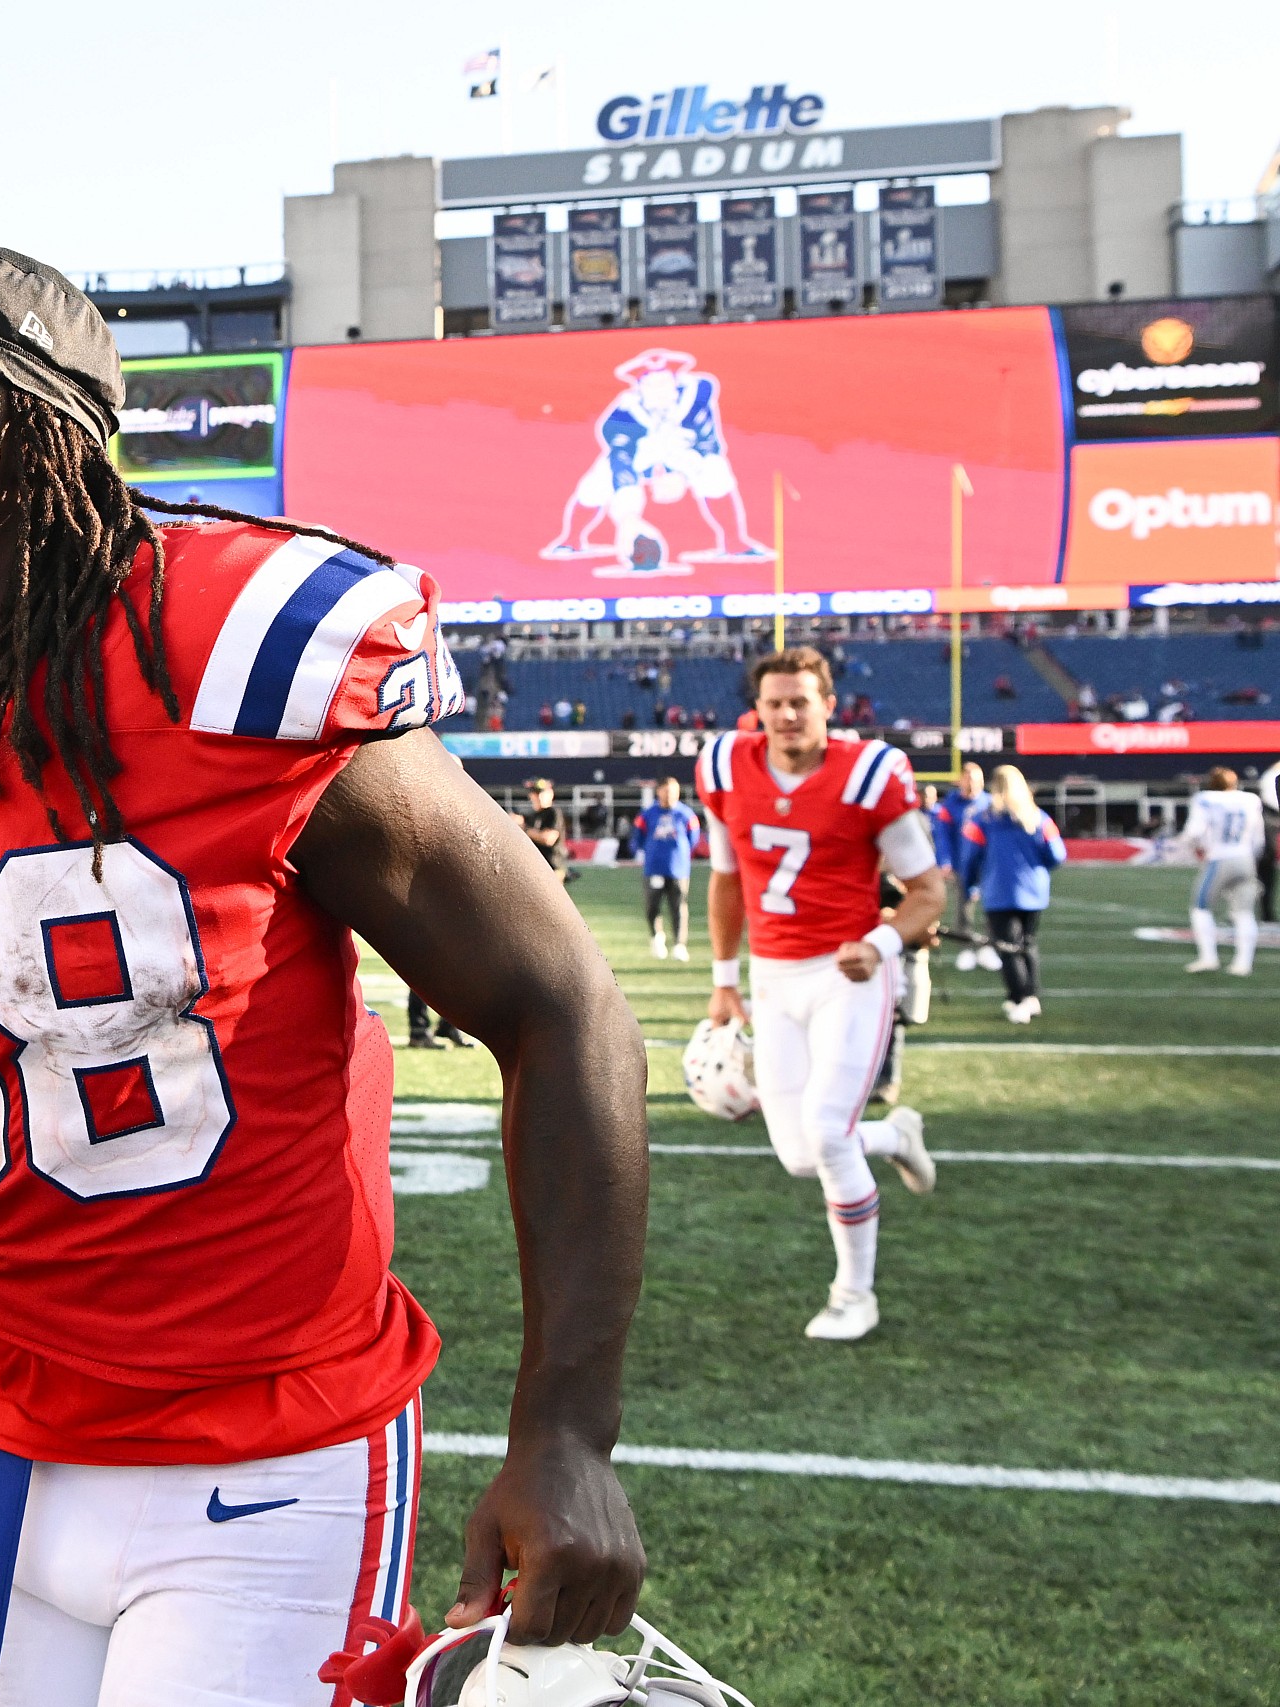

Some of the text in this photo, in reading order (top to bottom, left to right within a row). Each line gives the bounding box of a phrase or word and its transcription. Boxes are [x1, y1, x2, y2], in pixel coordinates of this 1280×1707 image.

[597, 84, 825, 145] Gillette
[582, 136, 845, 186] STADIUM
[1089, 487, 1272, 539] Optum
[513, 599, 605, 621] GEICO
[614, 596, 712, 619] GEICO
[723, 592, 821, 616] GEICO
[830, 589, 932, 614] GEICO
[629, 732, 677, 757] 2ND
[1091, 724, 1190, 753] Optum
[751, 823, 812, 916] 7
